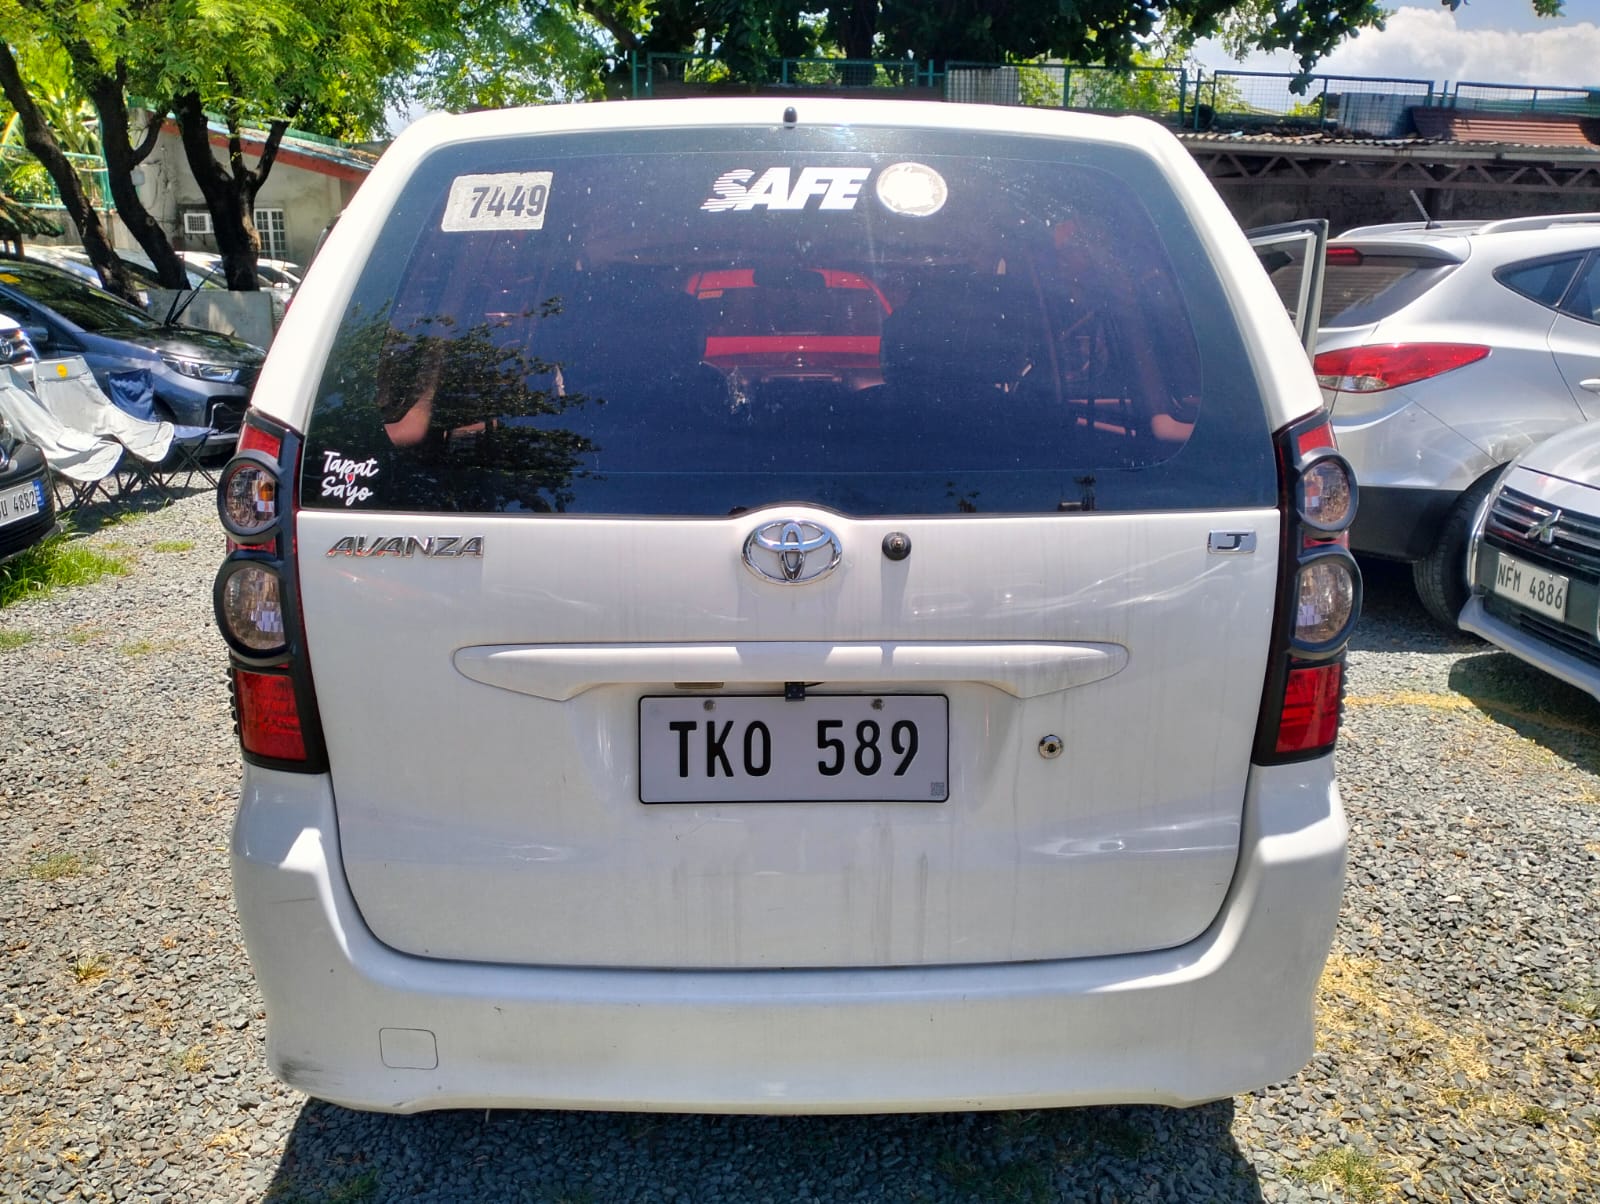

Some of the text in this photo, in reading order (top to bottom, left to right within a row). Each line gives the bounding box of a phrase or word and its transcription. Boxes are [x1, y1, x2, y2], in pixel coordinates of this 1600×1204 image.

[469, 184, 547, 218] 7449
[700, 167, 872, 212] SAFE
[323, 450, 380, 480] Tapat
[326, 535, 485, 559] AVANZA
[1497, 563, 1564, 610] NFM 4886
[669, 719, 919, 778] TKO 589
